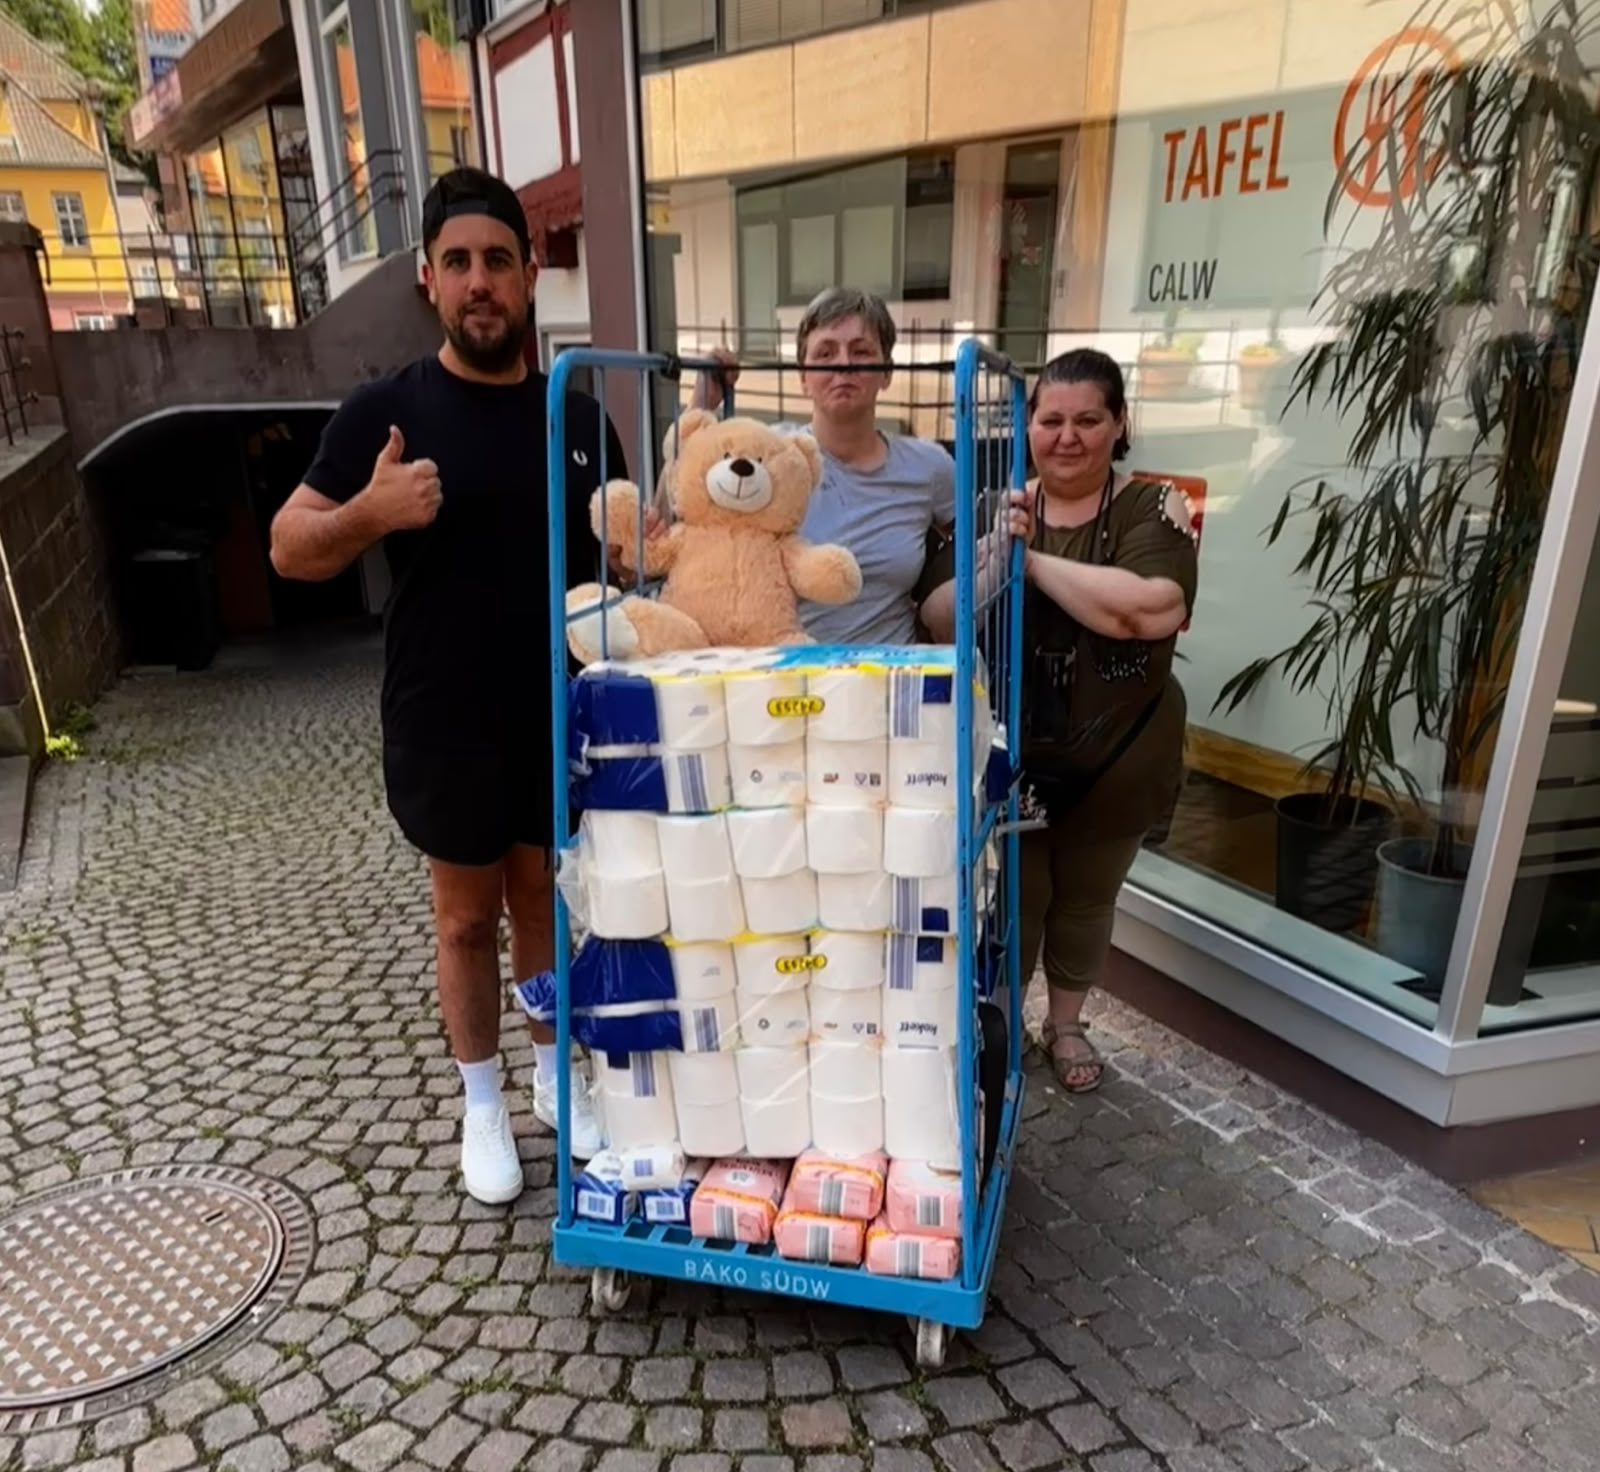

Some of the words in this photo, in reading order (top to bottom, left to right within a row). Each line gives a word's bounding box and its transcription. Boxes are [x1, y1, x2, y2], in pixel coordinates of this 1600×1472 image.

[1163, 111, 1290, 203] TAFEL
[1149, 258, 1218, 302] CALW
[899, 1021, 938, 1036] kokett
[684, 1258, 747, 1286] BÄKO
[760, 1268, 831, 1299] SÜDW
